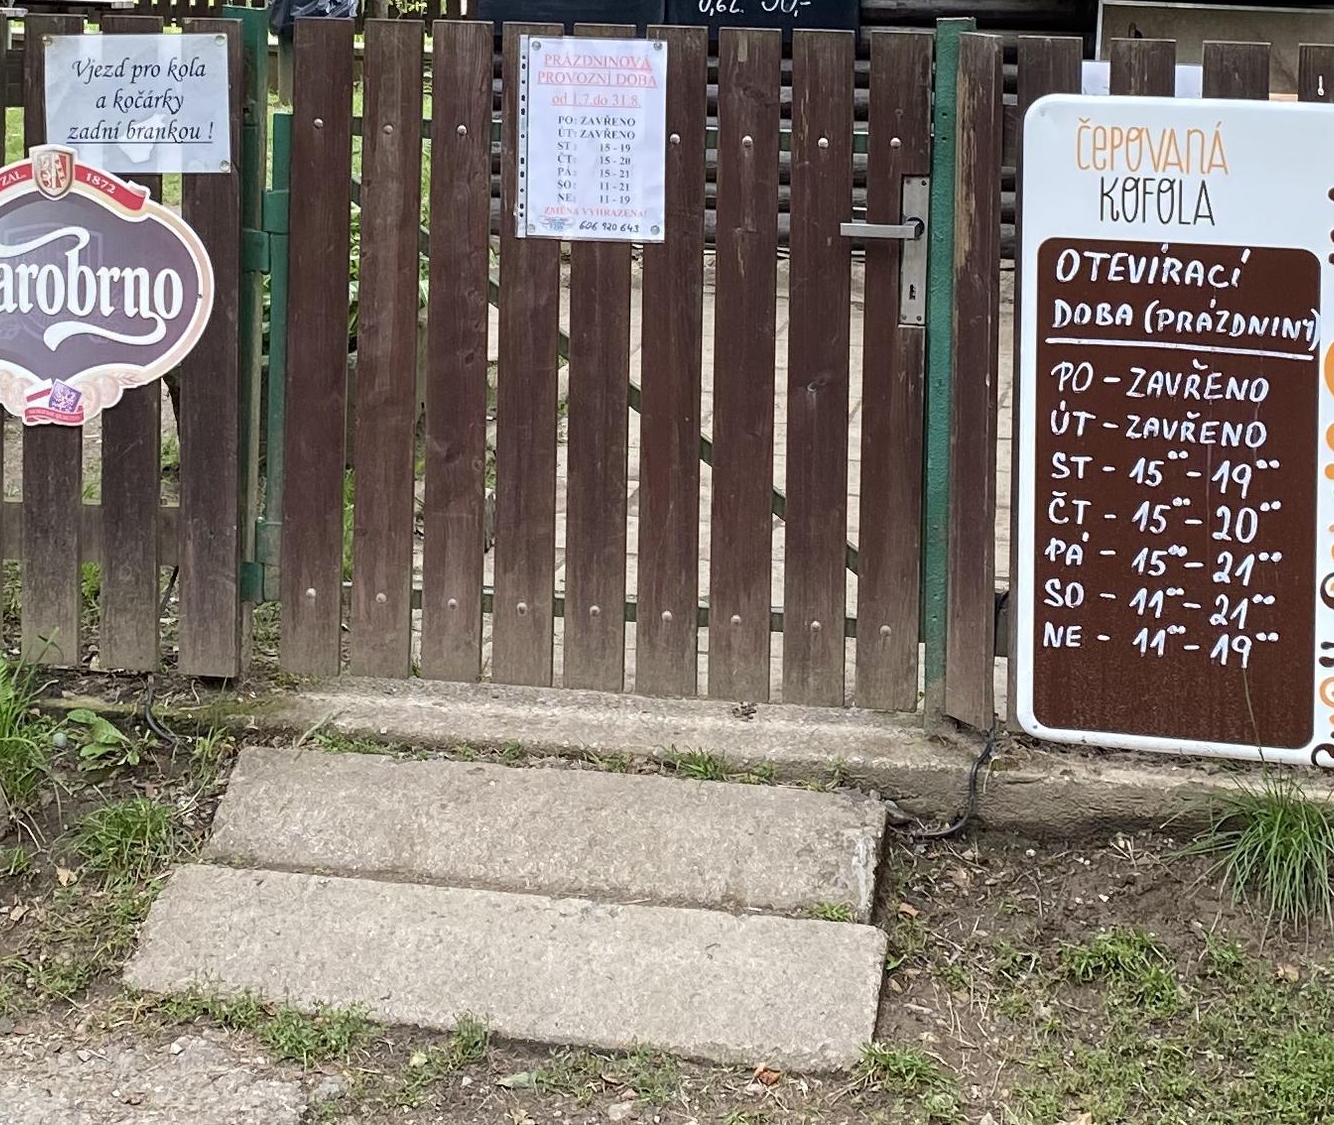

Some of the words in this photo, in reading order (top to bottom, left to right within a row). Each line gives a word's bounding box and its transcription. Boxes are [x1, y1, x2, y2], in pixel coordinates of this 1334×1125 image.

[71, 56, 126, 83] Vjezd
[130, 62, 161, 83] pro
[166, 56, 207, 79] kola
[544, 52, 652, 70] PRÁZDNINOVÁ
[538, 68, 611, 86] PROVOZNÍ
[616, 73, 657, 88] DOBA
[95, 94, 107, 109] a
[112, 88, 184, 116] kočárky
[552, 92, 567, 105] od
[67, 121, 119, 141] zadní
[125, 121, 202, 142] brankou
[580, 115, 636, 127] ZAVŘENO
[580, 128, 636, 140] ZAVŘENO
[621, 144, 631, 152] 19
[599, 156, 610, 165] 15
[85, 173, 116, 194] 1872
[599, 169, 610, 178] 15
[620, 170, 629, 178] 21
[600, 182, 609, 191] 11
[619, 183, 629, 191] 21
[599, 195, 609, 204] 11
[620, 196, 631, 204] 19
[1098, 175, 1216, 227] KOFOLA
[579, 220, 598, 231] 606
[602, 222, 618, 231] 920
[620, 223, 640, 233] 643
[1055, 243, 1251, 289] OTEVÍRACÍ
[1051, 298, 1133, 328] DOBA
[1144, 298, 1320, 352] (PRÁZDNINY)
[1050, 361, 1094, 394] PO
[1125, 358, 1270, 403] ZAVŘENO
[1050, 400, 1096, 437] ÚT
[1125, 410, 1268, 448] ZAVŘENO
[1051, 451, 1093, 480] ST
[1048, 490, 1091, 525] ČT
[1044, 531, 1089, 566] PÁ
[1043, 578, 1085, 608] SO
[1043, 621, 1083, 649] NE
